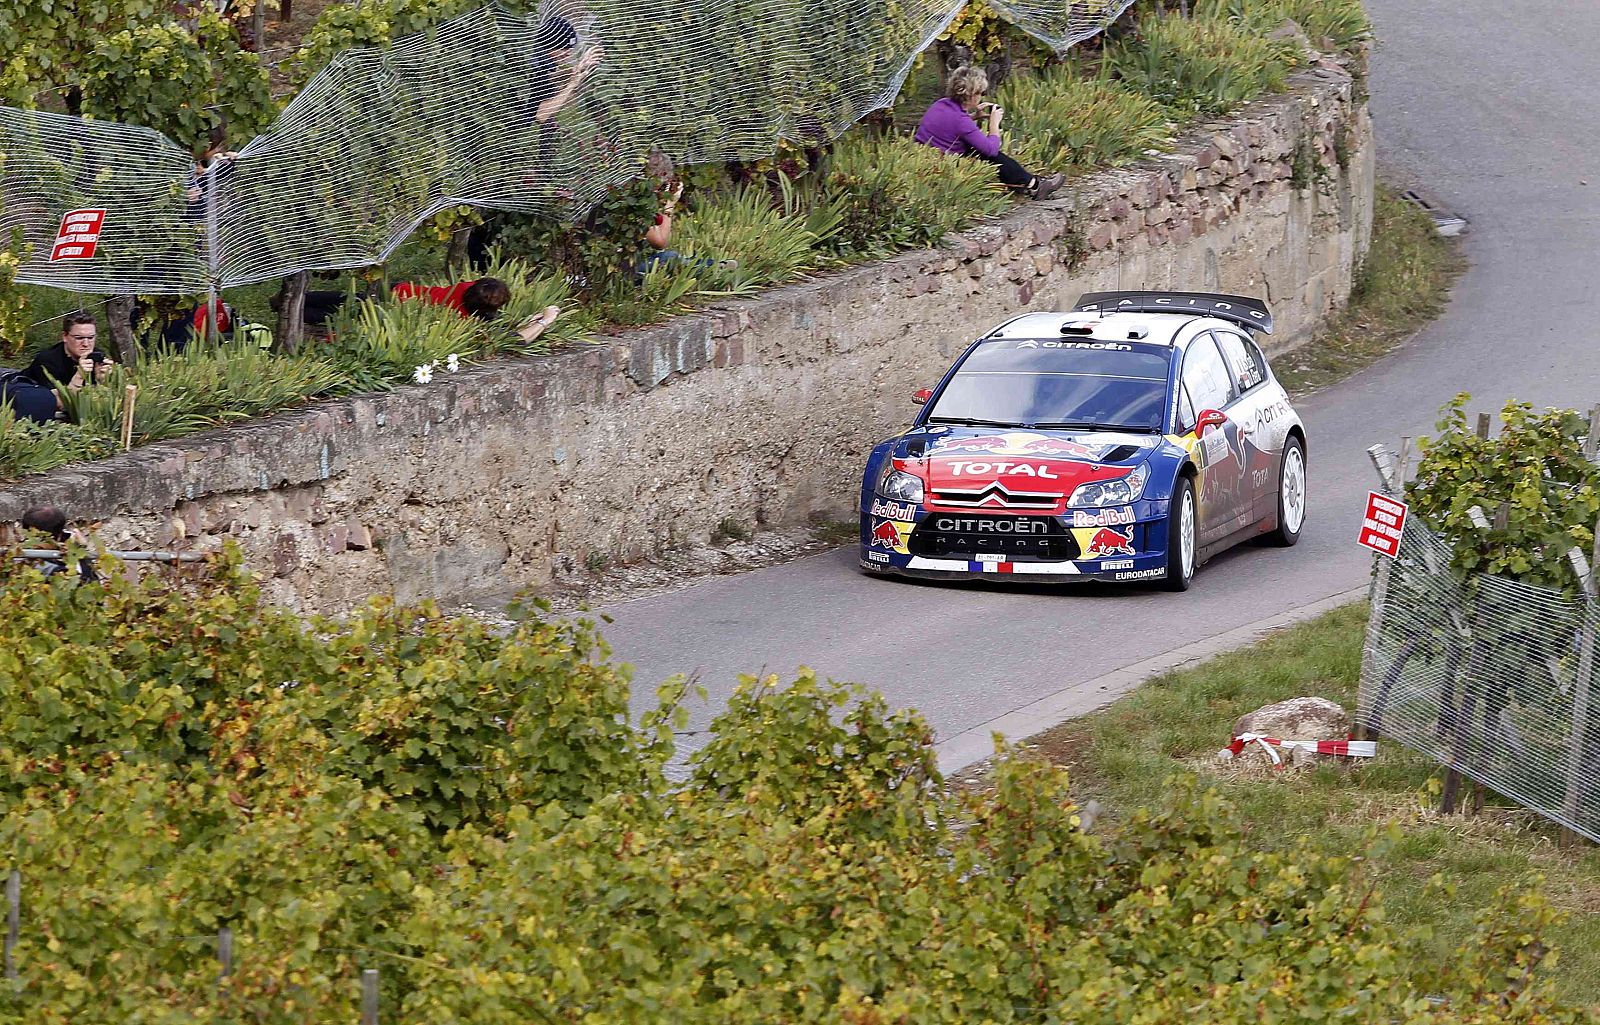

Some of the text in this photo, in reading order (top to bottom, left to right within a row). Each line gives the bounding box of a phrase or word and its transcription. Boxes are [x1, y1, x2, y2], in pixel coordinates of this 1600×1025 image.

[947, 461, 1058, 479] TOTAL
[1252, 467, 1268, 489] TOTA
[888, 502, 917, 521] Bull
[1074, 505, 1136, 527] Red Bull
[936, 517, 1048, 533] CITROËN
[936, 536, 1049, 546] RACING
[1115, 567, 1165, 580] EURODATACAR
